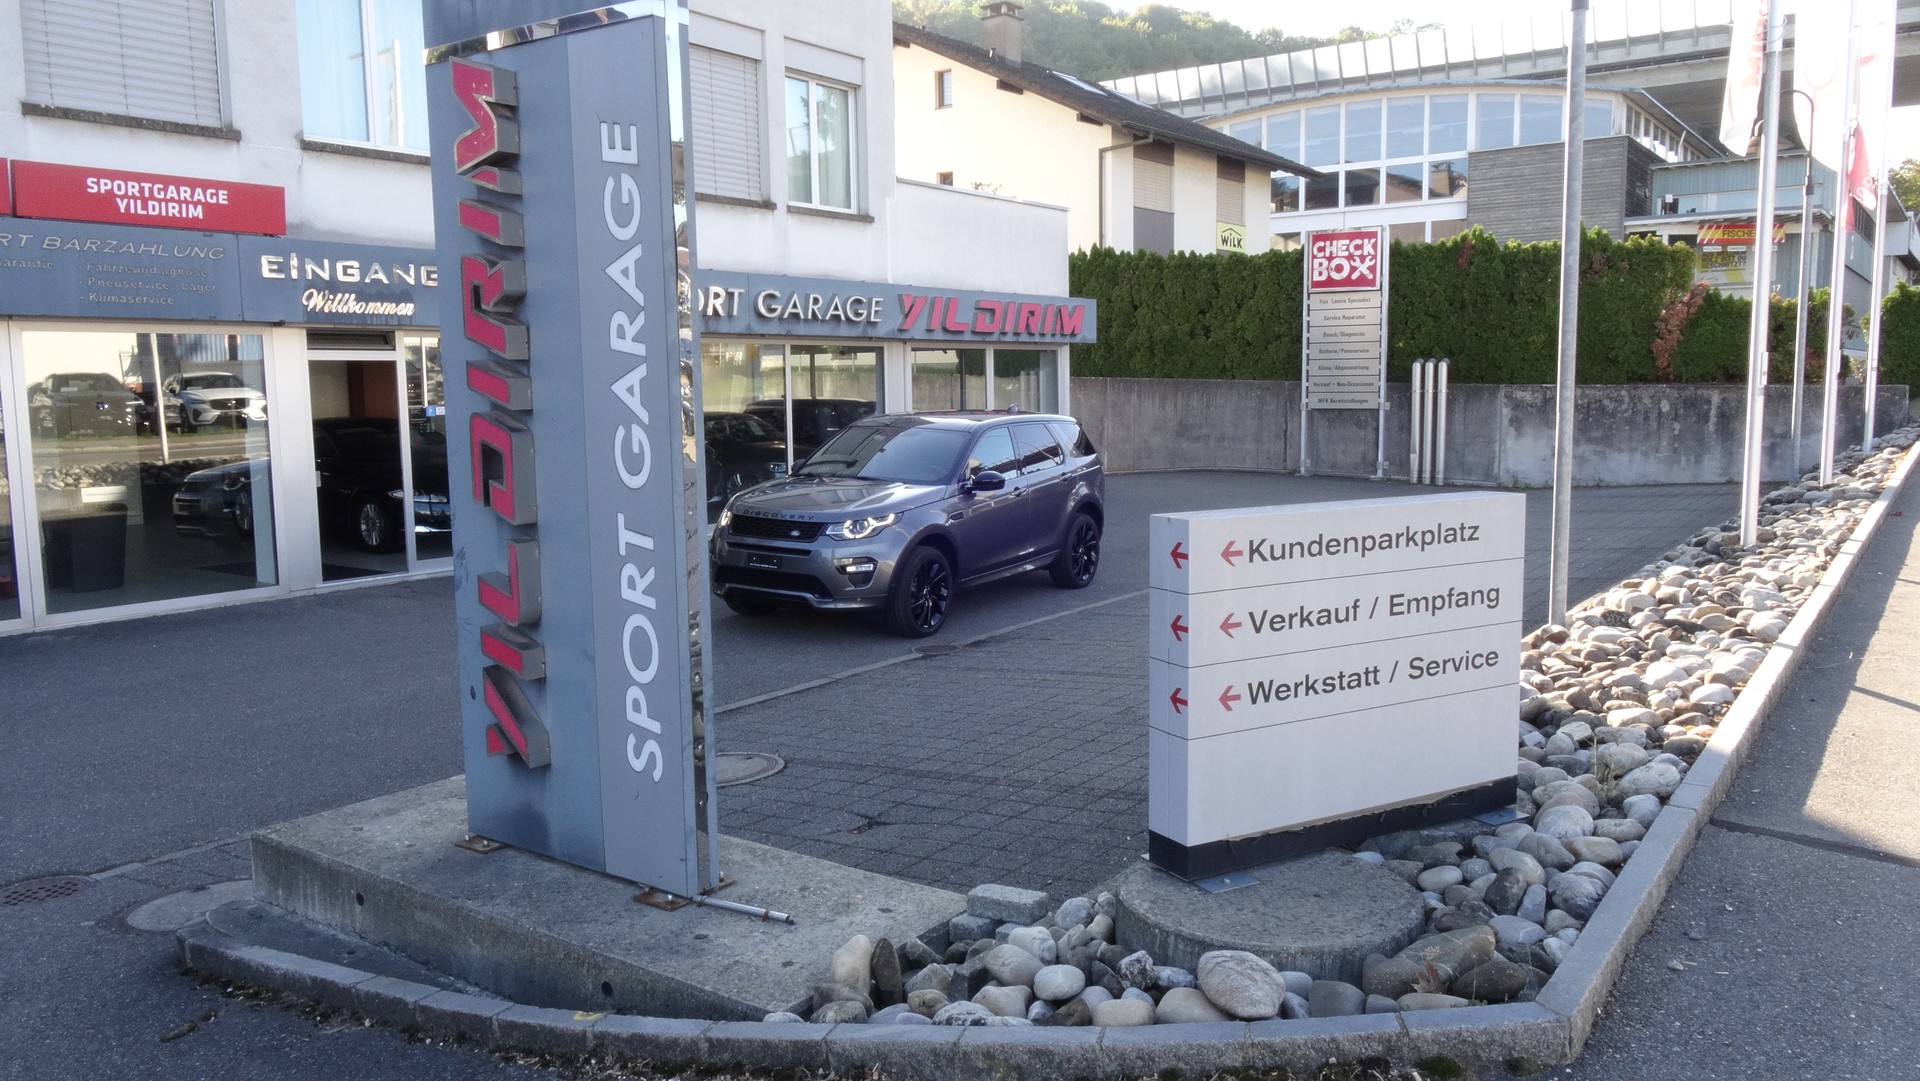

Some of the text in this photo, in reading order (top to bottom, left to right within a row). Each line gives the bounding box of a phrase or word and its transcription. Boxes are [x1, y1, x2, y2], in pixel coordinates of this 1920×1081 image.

[86, 177, 229, 205] SPORTGARAGE
[116, 197, 204, 220] YILDIRIM
[1312, 237, 1377, 258] CHECK
[1722, 229, 1755, 238] FISCHE
[42, 236, 225, 260] BARZAHLUNG
[88, 291, 175, 305] Klimaservice
[1772, 284, 1781, 292] 17
[302, 288, 416, 317] Willkommen
[755, 288, 884, 323] GARAGE
[897, 292, 1086, 336] YILDIRIM
[449, 55, 550, 769] YILDIRIM
[600, 120, 663, 783] SPORT GARAGE
[742, 509, 816, 521] DISCOVERY
[1248, 522, 1480, 563] Kundenparkplatz
[1248, 599, 1360, 635] Verkauf
[1389, 586, 1501, 618] Empfang
[1247, 665, 1381, 706] Werkstatt
[1408, 650, 1500, 681] Service
